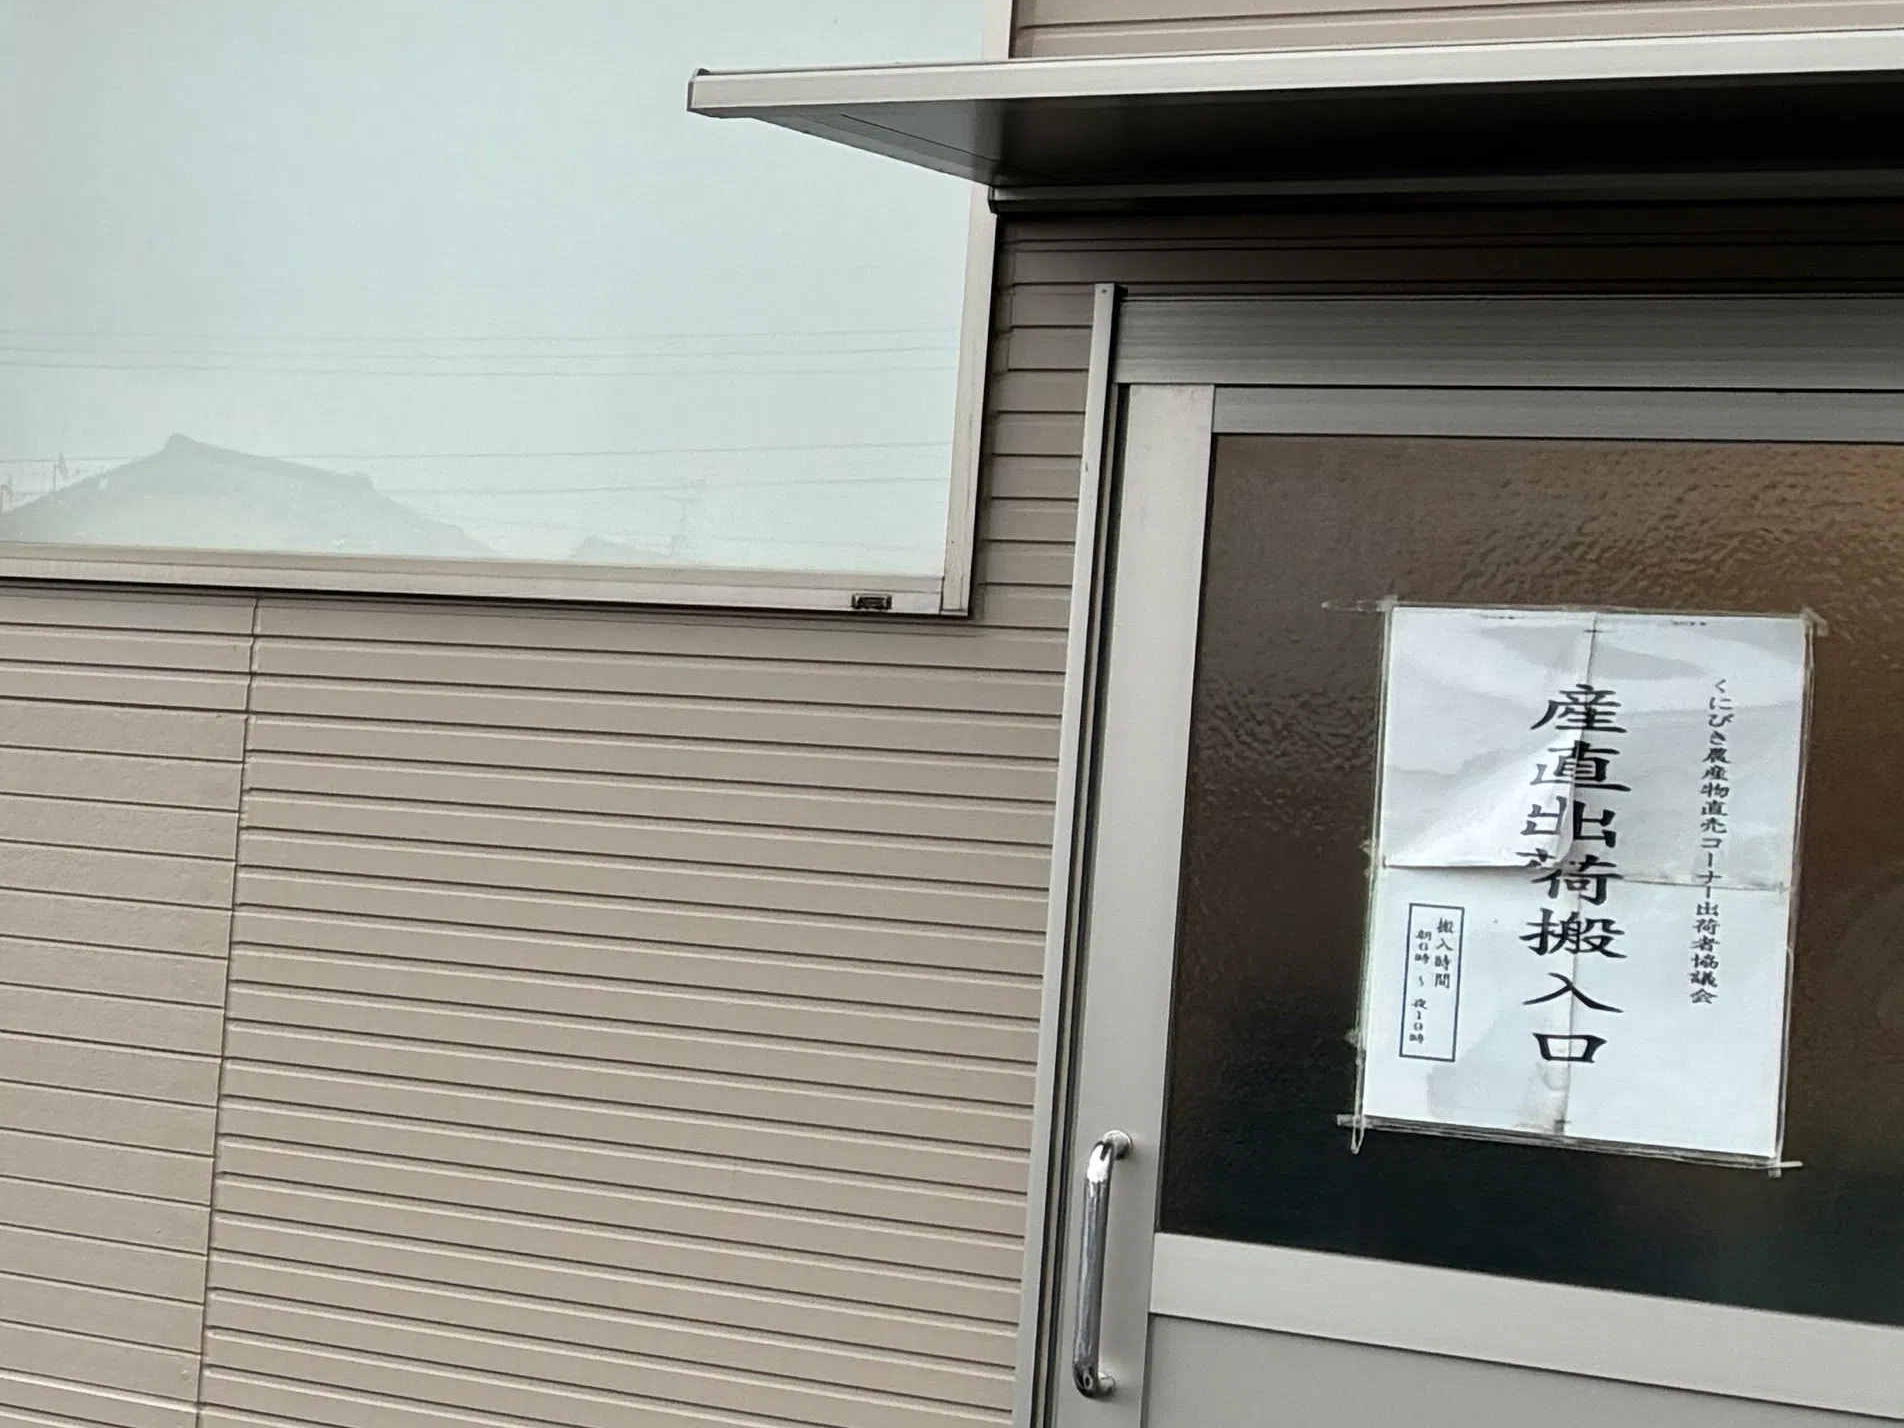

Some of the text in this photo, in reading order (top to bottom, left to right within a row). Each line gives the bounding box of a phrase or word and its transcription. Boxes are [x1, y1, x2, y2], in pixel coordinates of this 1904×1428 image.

[1515, 683, 1631, 1064] 産直出荷搬入口
